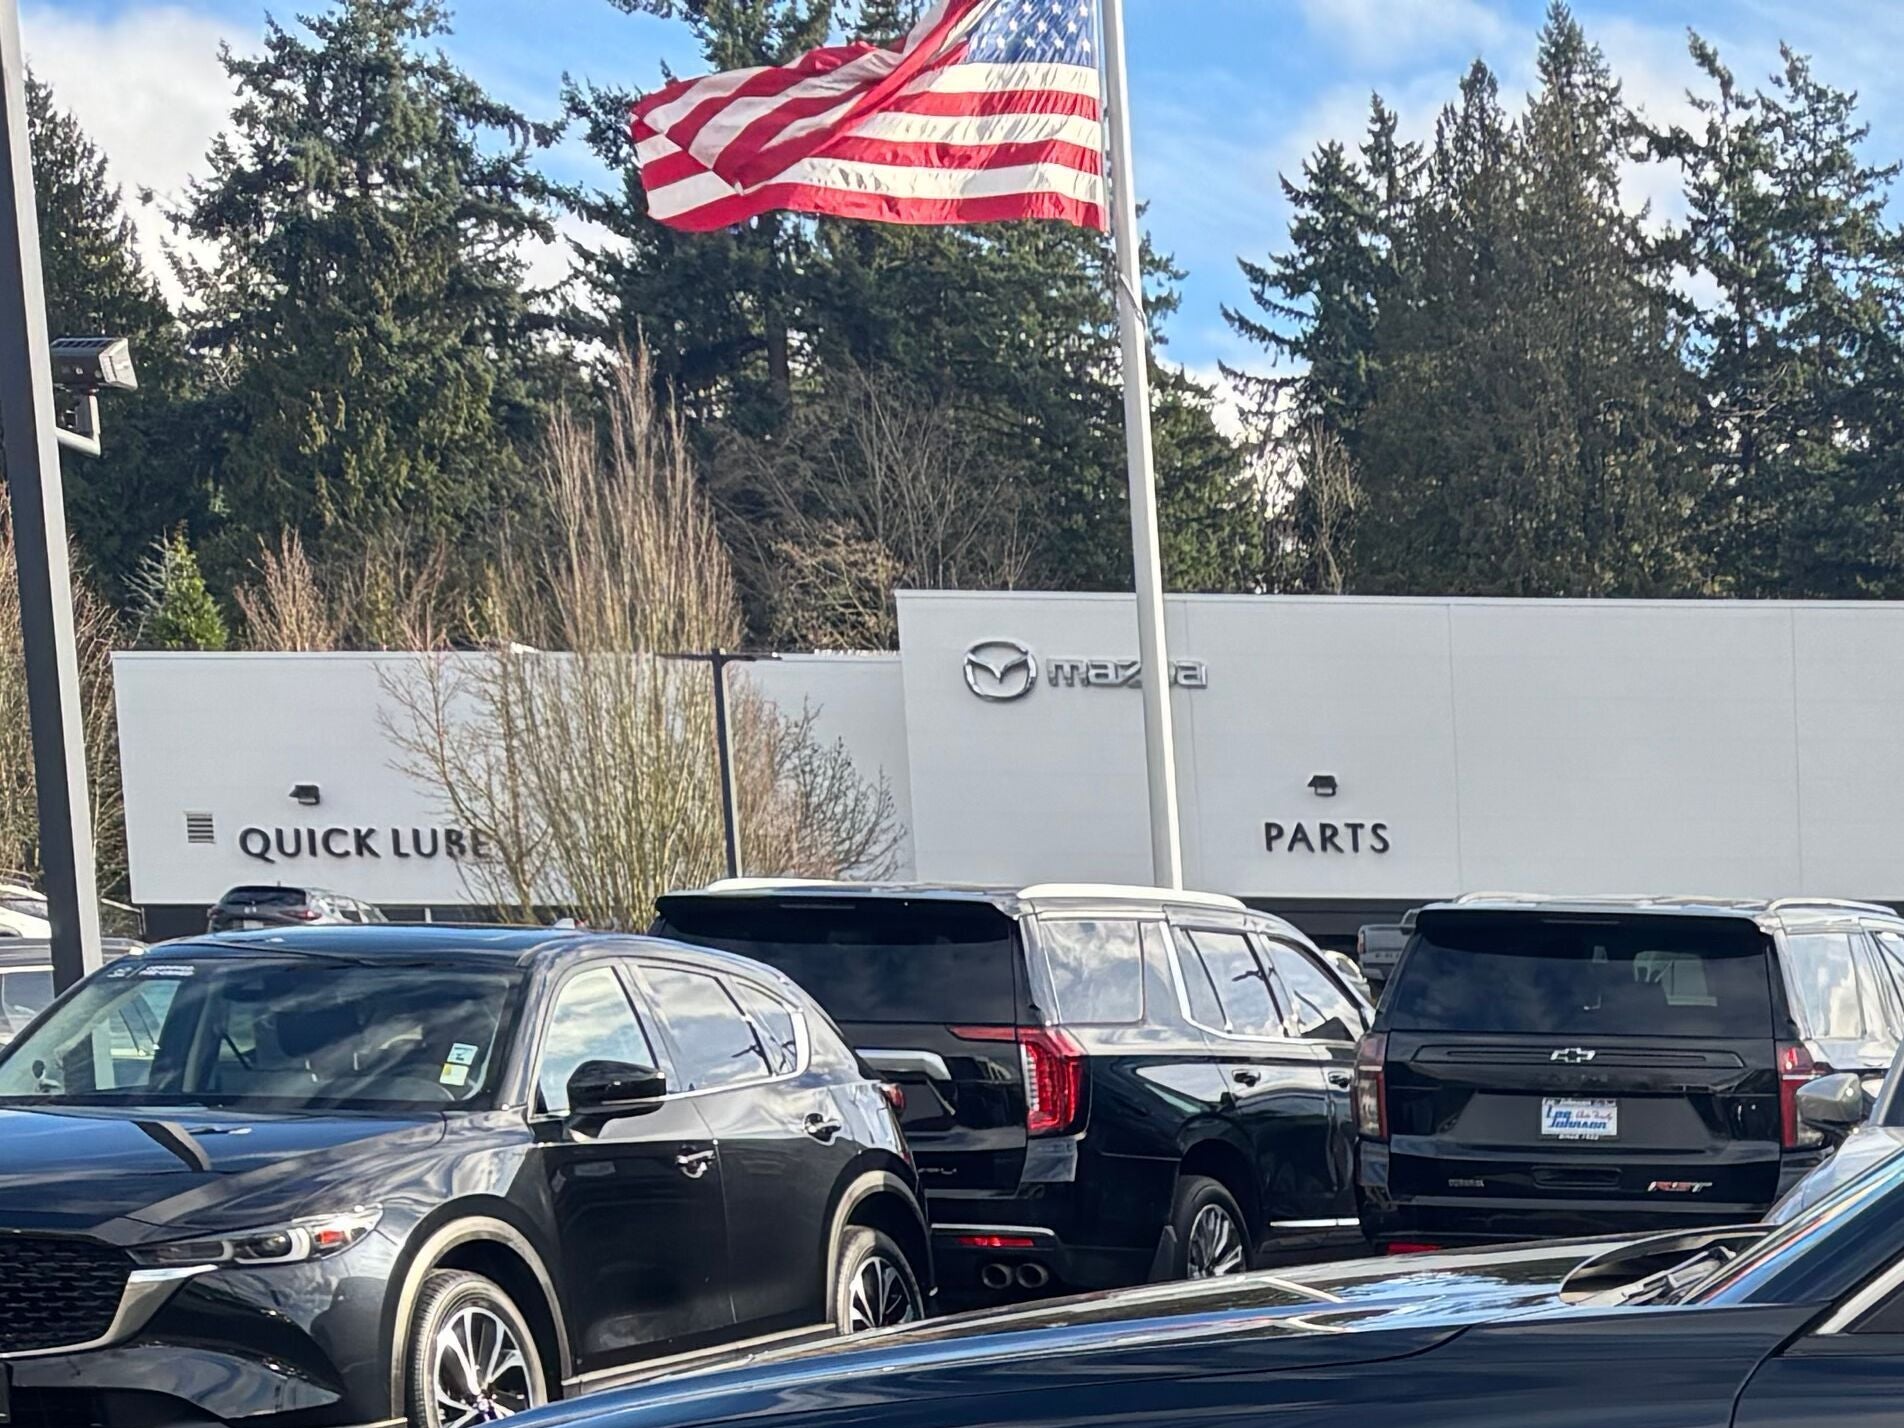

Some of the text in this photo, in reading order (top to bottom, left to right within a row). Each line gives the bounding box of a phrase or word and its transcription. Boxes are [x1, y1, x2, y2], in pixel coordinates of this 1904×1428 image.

[1046, 659, 1208, 689] maza
[238, 827, 491, 864] QUICK LUBE
[1264, 821, 1390, 853] PARTS
